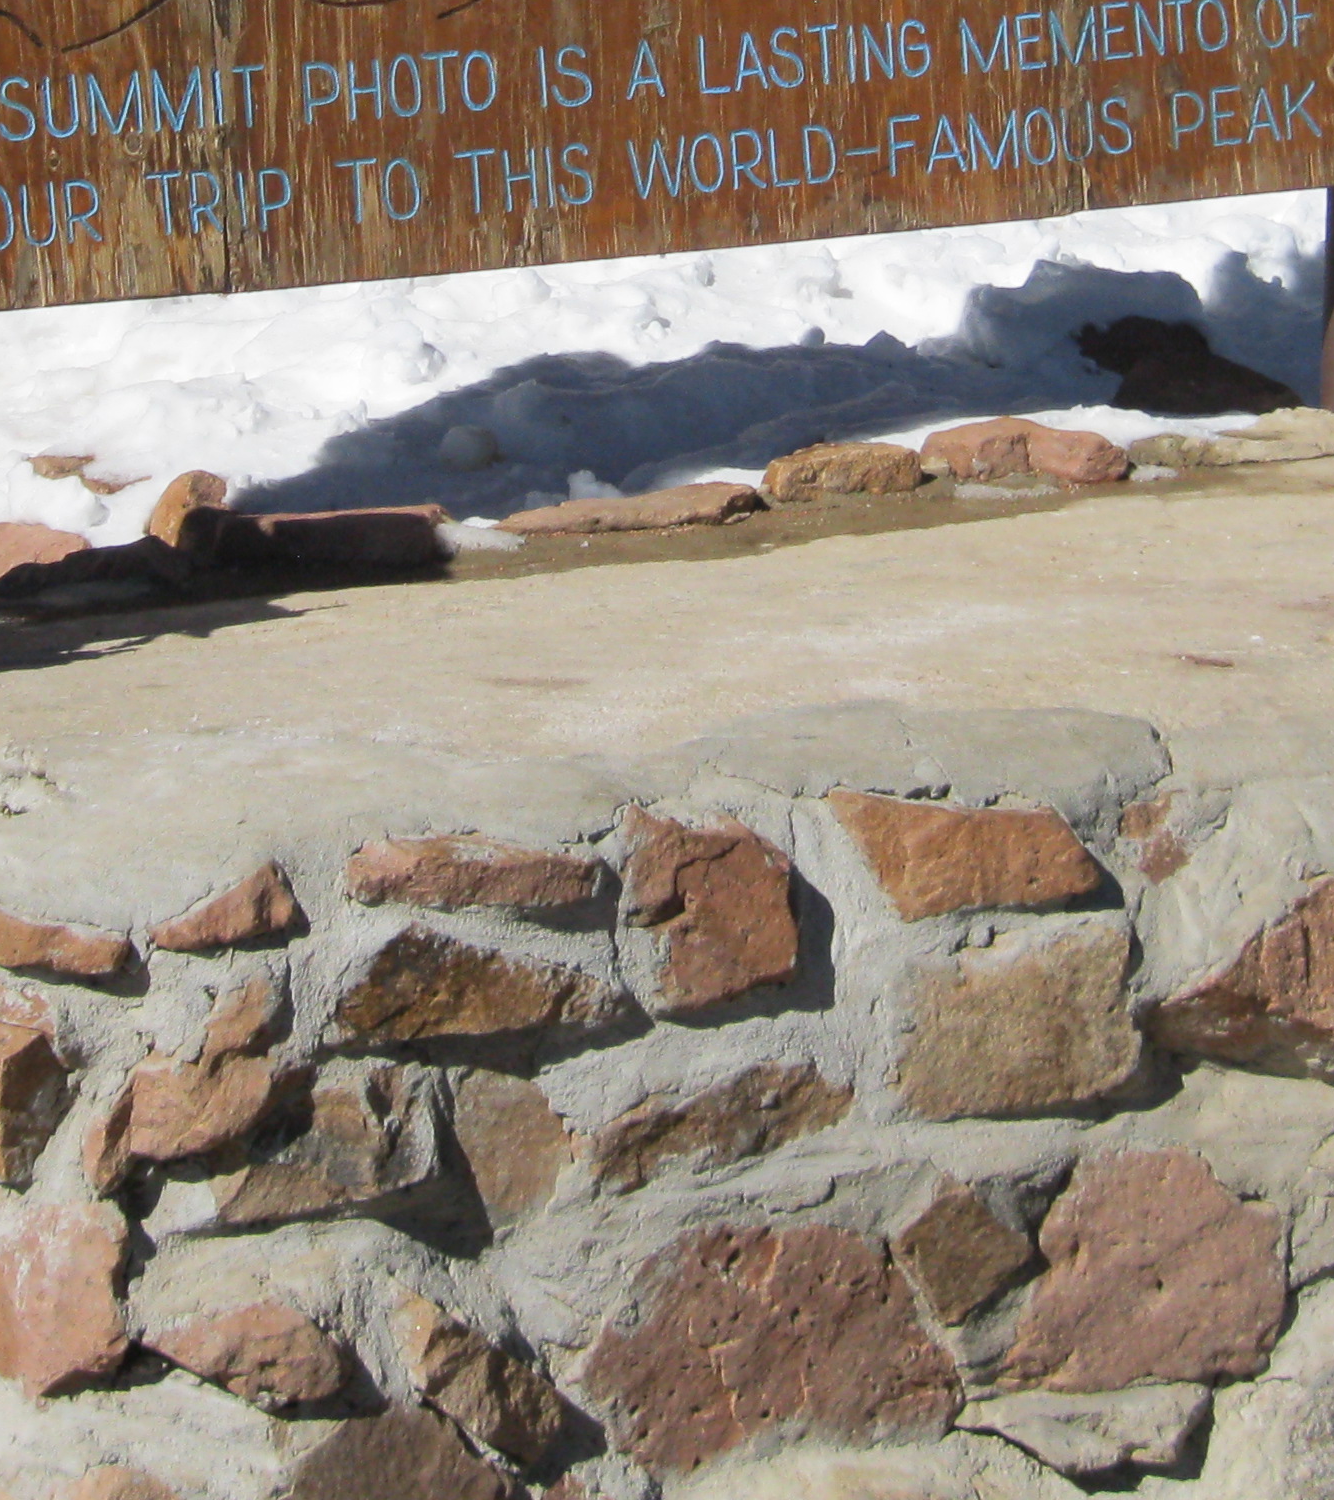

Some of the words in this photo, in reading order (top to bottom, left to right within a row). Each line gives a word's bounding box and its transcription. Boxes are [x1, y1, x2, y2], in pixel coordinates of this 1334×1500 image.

[302, 50, 498, 125] PHOTO
[538, 45, 594, 109] IS
[627, 39, 666, 101] A
[698, 19, 932, 96] LASTING
[145, 167, 293, 235] TRIP
[336, 155, 423, 225] TO
[455, 142, 594, 215] THIS
[627, 96, 1134, 202] WORLD-FAMOUS
[1171, 80, 1324, 150] PEAK
